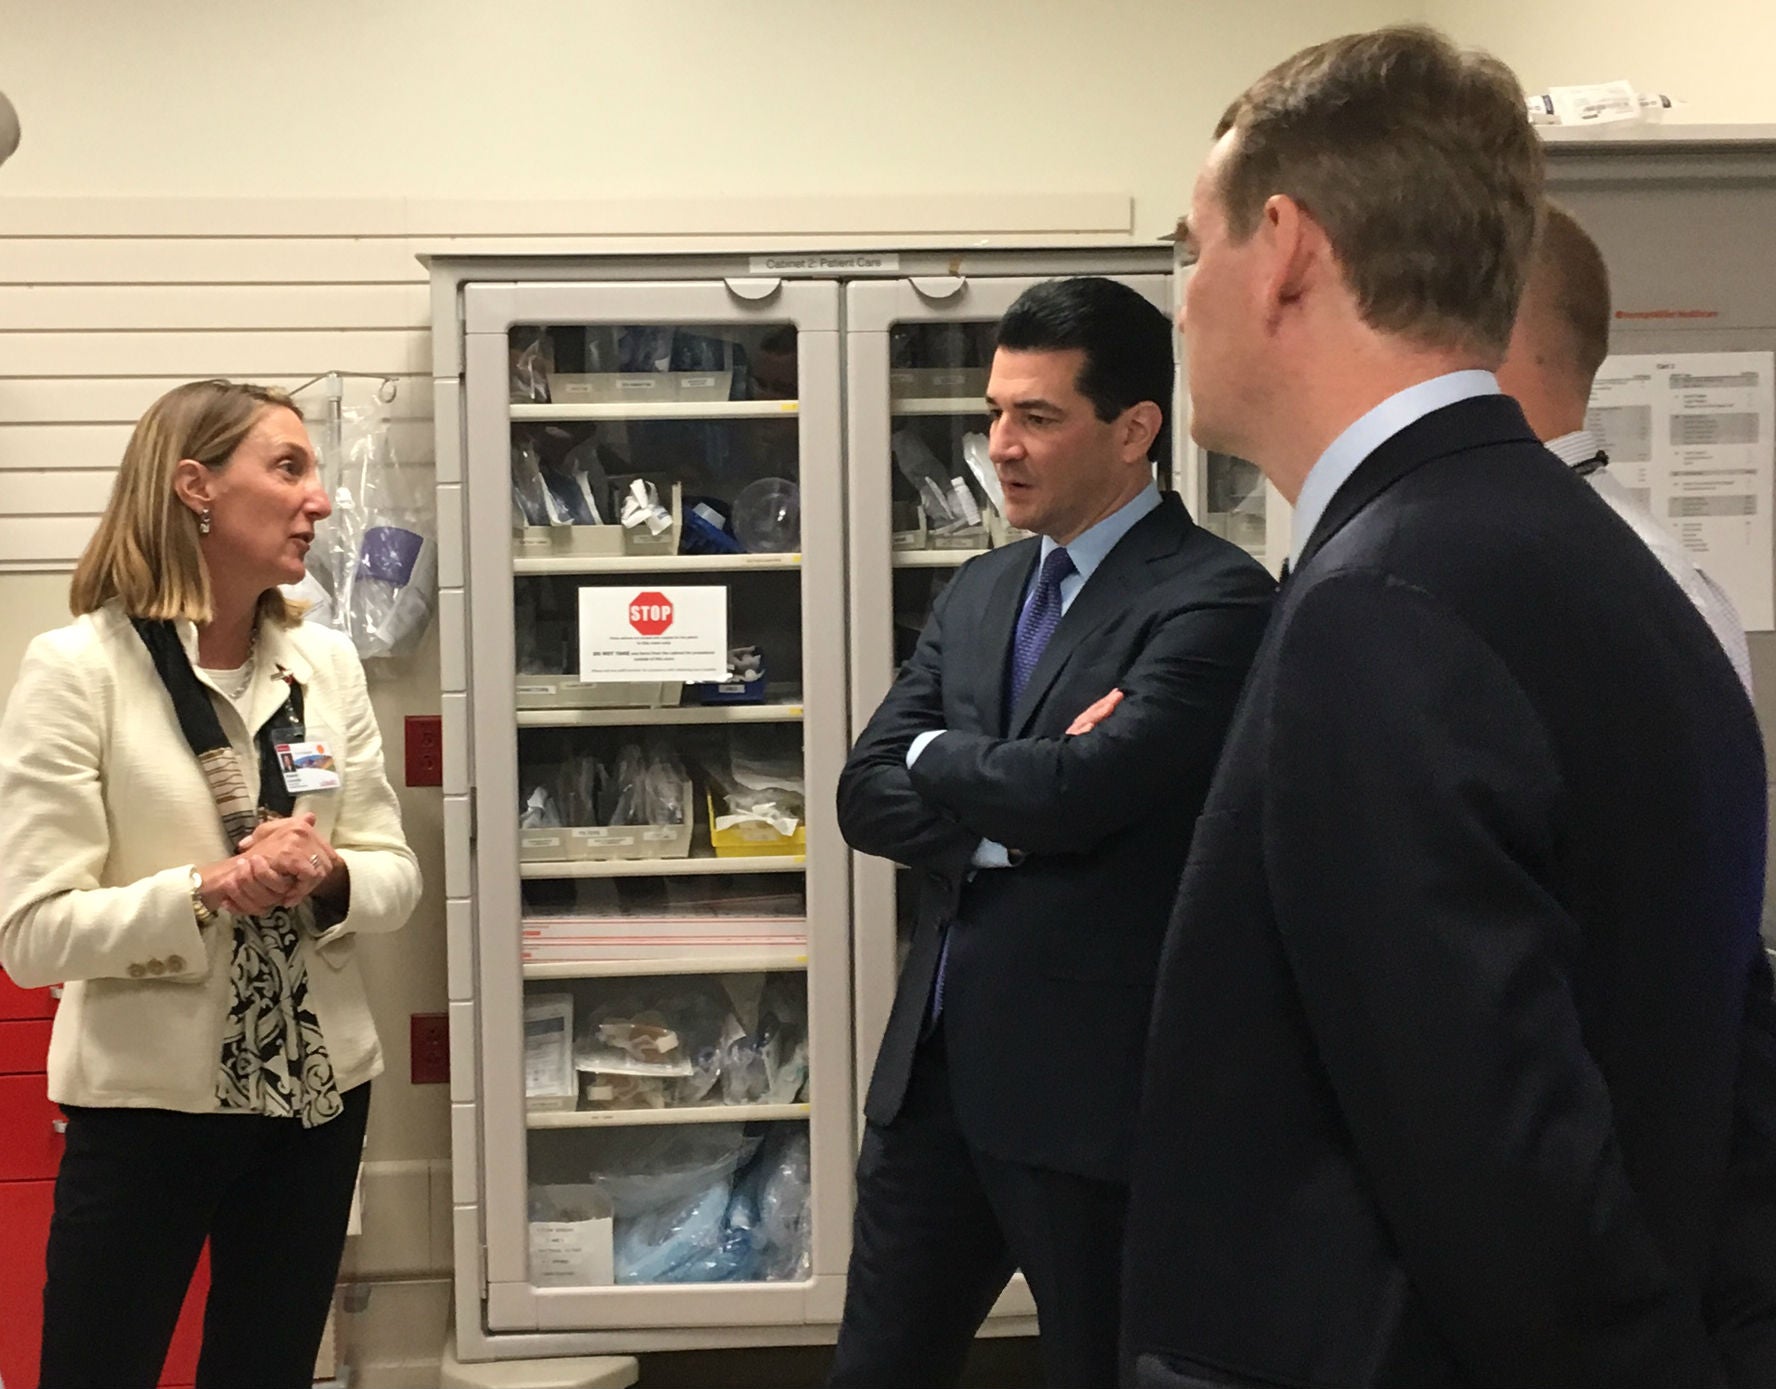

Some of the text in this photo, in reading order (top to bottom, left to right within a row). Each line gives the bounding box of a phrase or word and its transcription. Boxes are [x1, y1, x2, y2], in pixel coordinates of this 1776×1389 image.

[766, 258, 805, 269] Cabinet
[820, 257, 855, 268] Patient
[856, 257, 882, 267] Care
[630, 605, 671, 622] STOP
